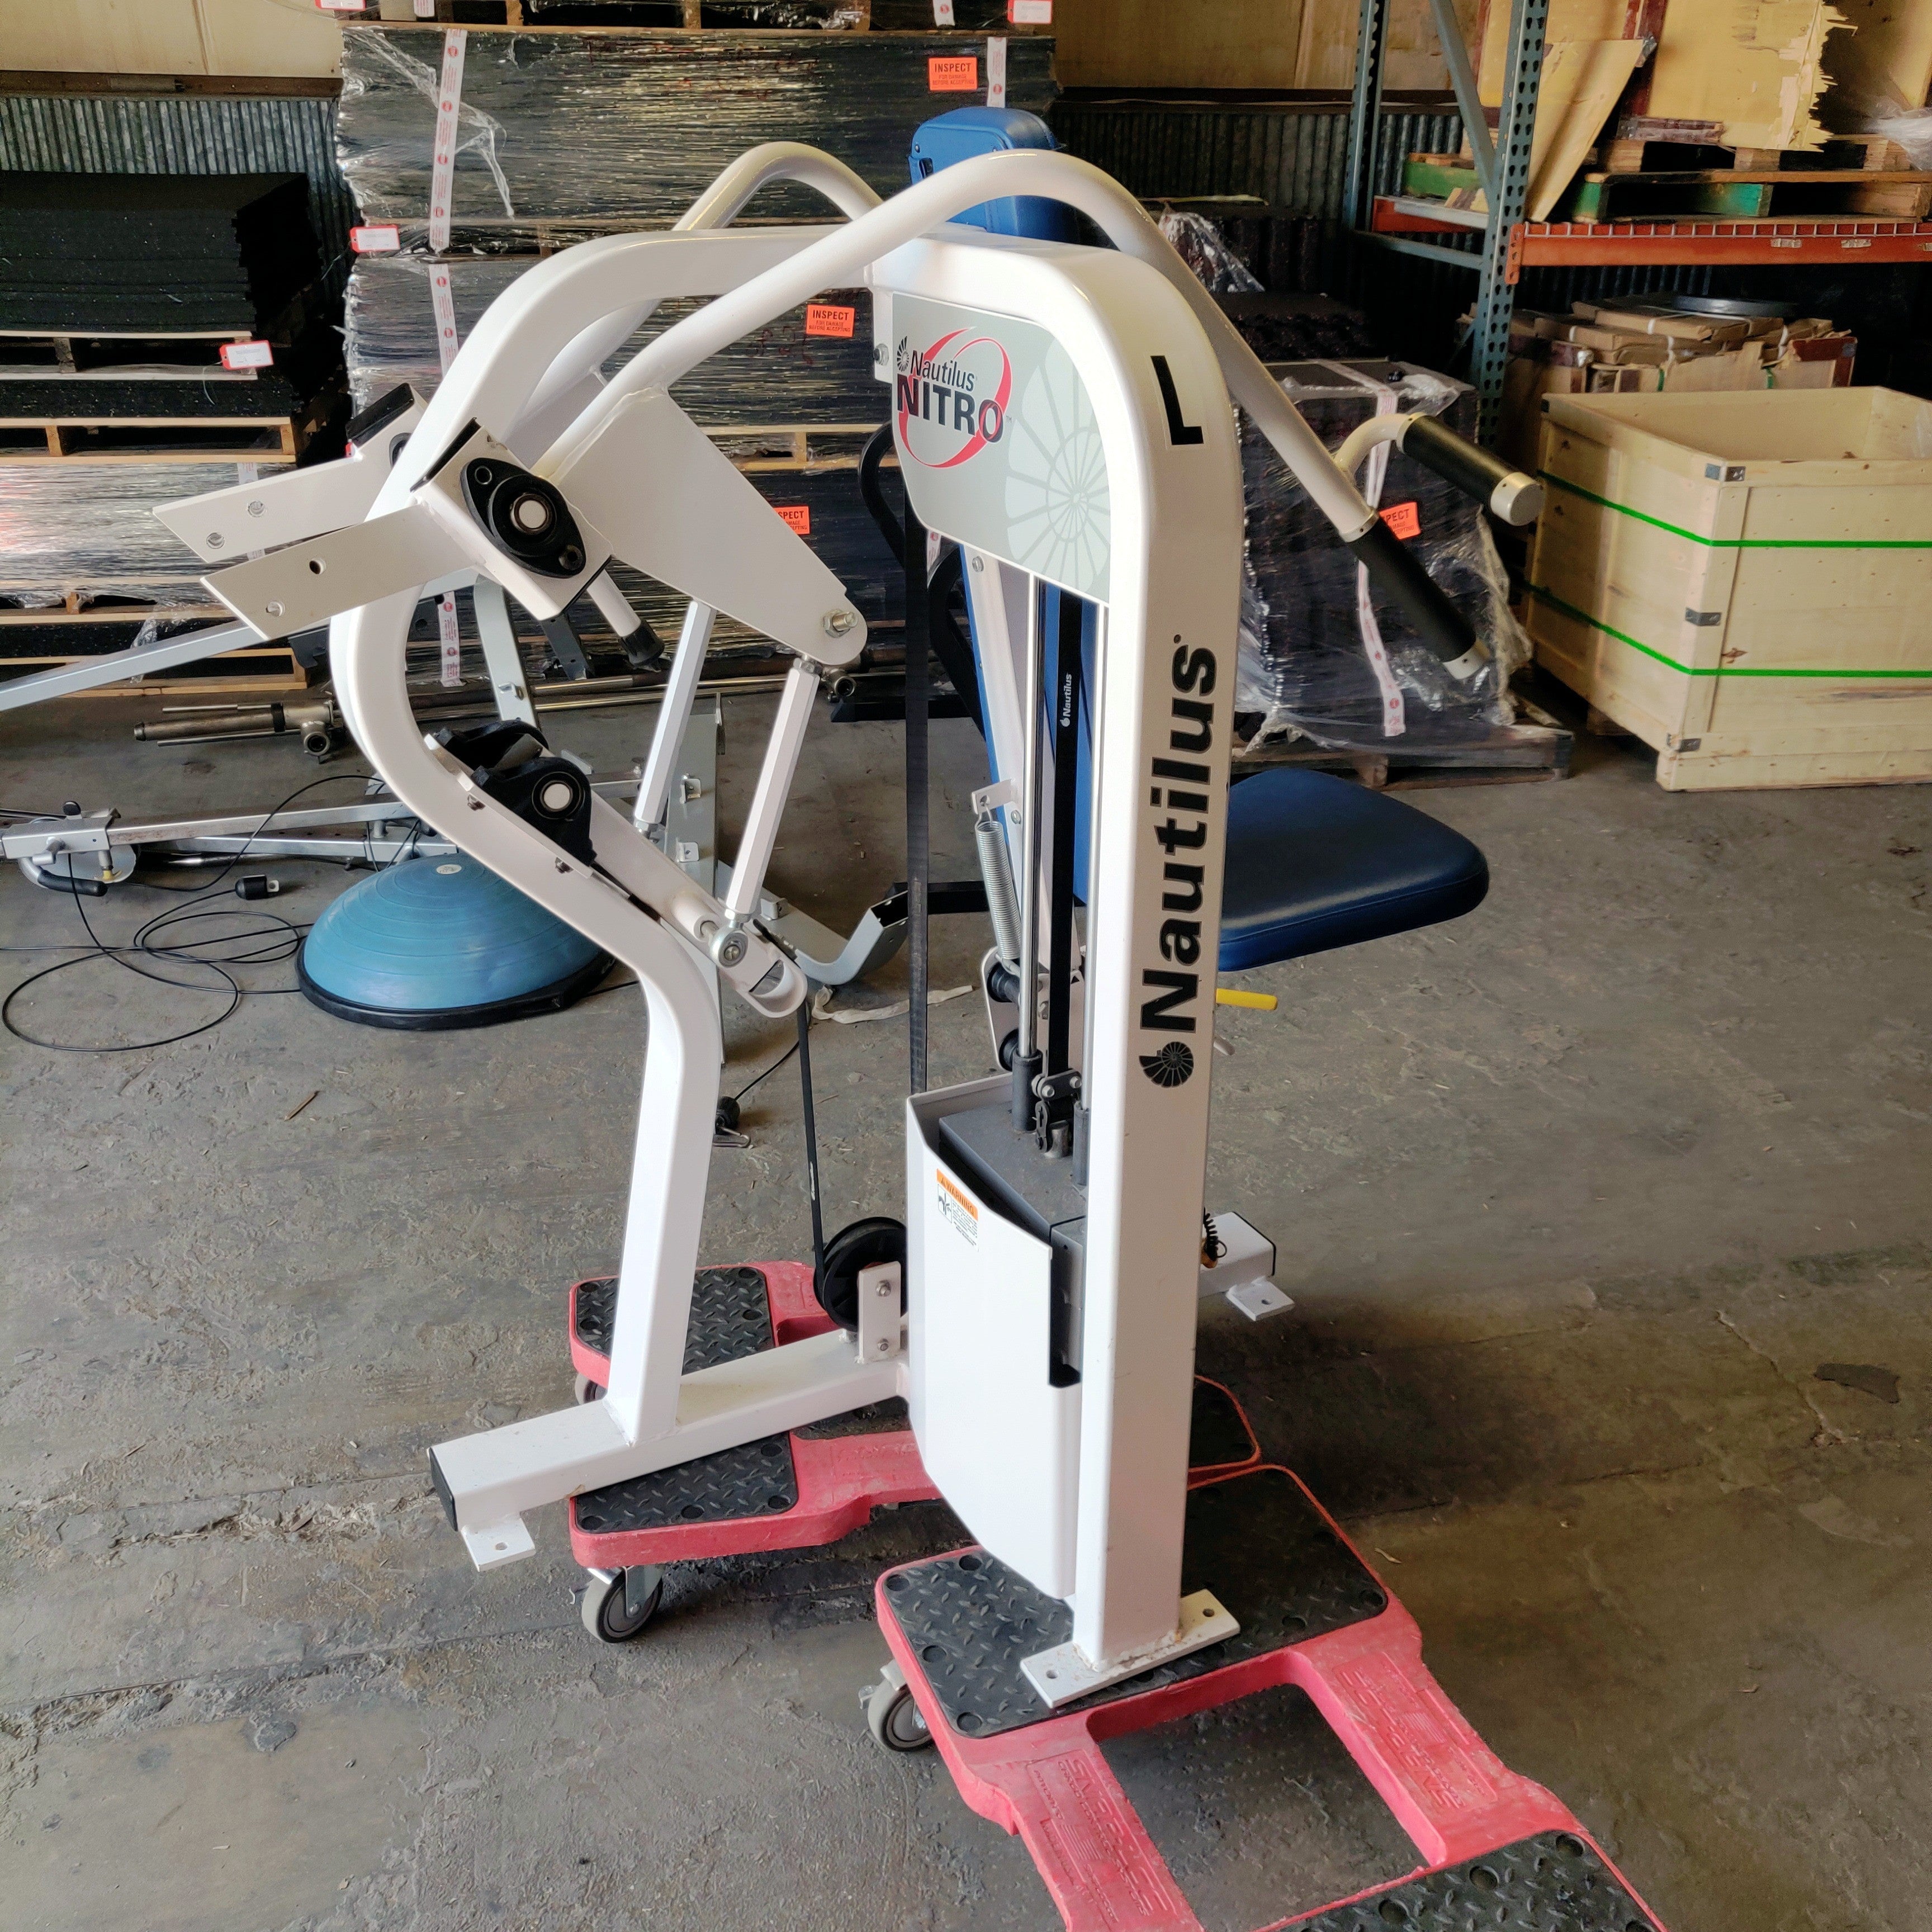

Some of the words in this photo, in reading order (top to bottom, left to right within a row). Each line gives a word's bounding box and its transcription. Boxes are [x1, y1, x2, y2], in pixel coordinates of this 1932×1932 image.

[935, 63, 971, 73] INSPECT
[812, 309, 849, 321] INSPECT
[910, 349, 974, 391] Nautilus
[897, 373, 1004, 443] NITRO
[1150, 355, 1204, 446] L
[1385, 509, 1410, 522] PECT
[1063, 674, 1072, 717] Nautilus
[1139, 644, 1217, 1034] Nautilus
[946, 1181, 975, 1215] WARNING
